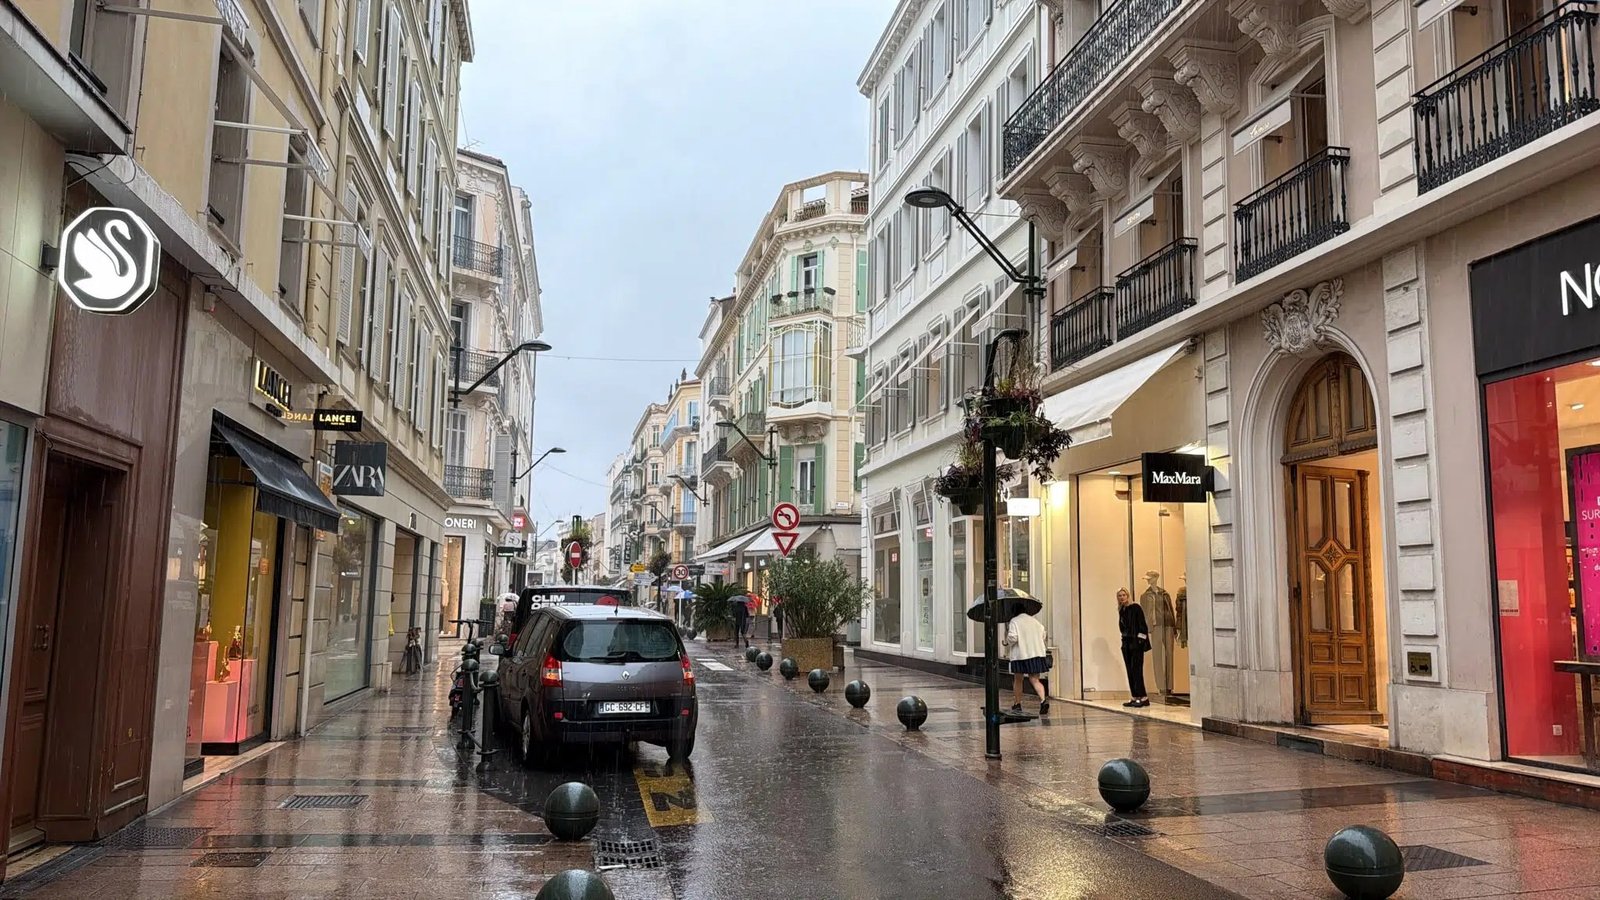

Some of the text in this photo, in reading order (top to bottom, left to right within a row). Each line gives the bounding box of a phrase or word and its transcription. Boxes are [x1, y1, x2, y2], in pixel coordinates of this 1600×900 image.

[319, 413, 357, 423] LANCEL
[333, 464, 385, 488] ZARA
[1151, 471, 1202, 485] MaxMara
[675, 568, 686, 577] 30
[531, 594, 565, 602] CLIM
